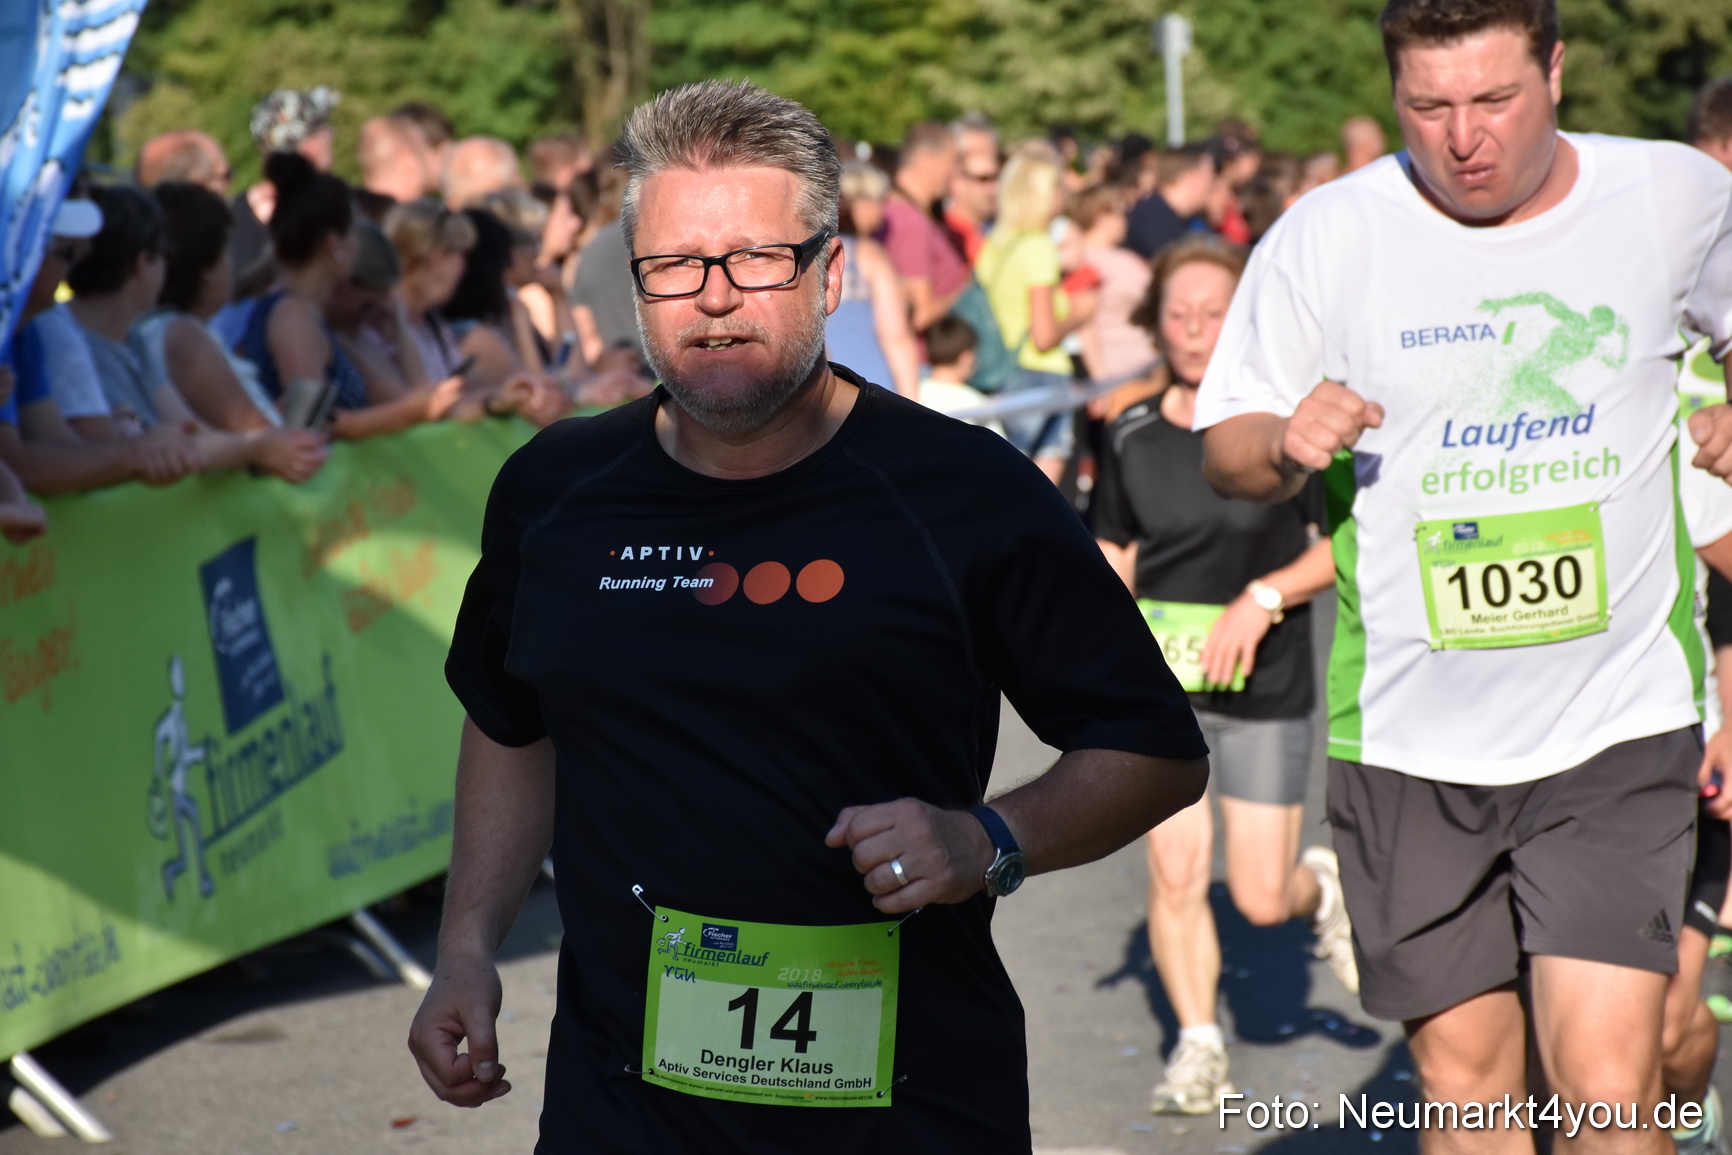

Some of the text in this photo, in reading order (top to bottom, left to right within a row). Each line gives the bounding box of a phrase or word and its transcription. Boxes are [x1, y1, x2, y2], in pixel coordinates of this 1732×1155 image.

[1401, 323, 1496, 349] BERATA
[1442, 403, 1596, 452] Laufend
[1421, 446, 1621, 495] erfolgreich
[620, 546, 704, 560] APTIV
[599, 576, 714, 591] Running Team
[1447, 555, 1582, 610] 1030
[1471, 606, 1569, 625] Meier Gerhard
[682, 957, 720, 968] neumarkt
[684, 942, 770, 967] firmenlauf
[777, 967, 822, 982] 2018
[728, 987, 817, 1054] 14
[658, 1058, 872, 1089] Aptiv Services Deutschland GmbH
[700, 1049, 834, 1075] Dengler Klaus
